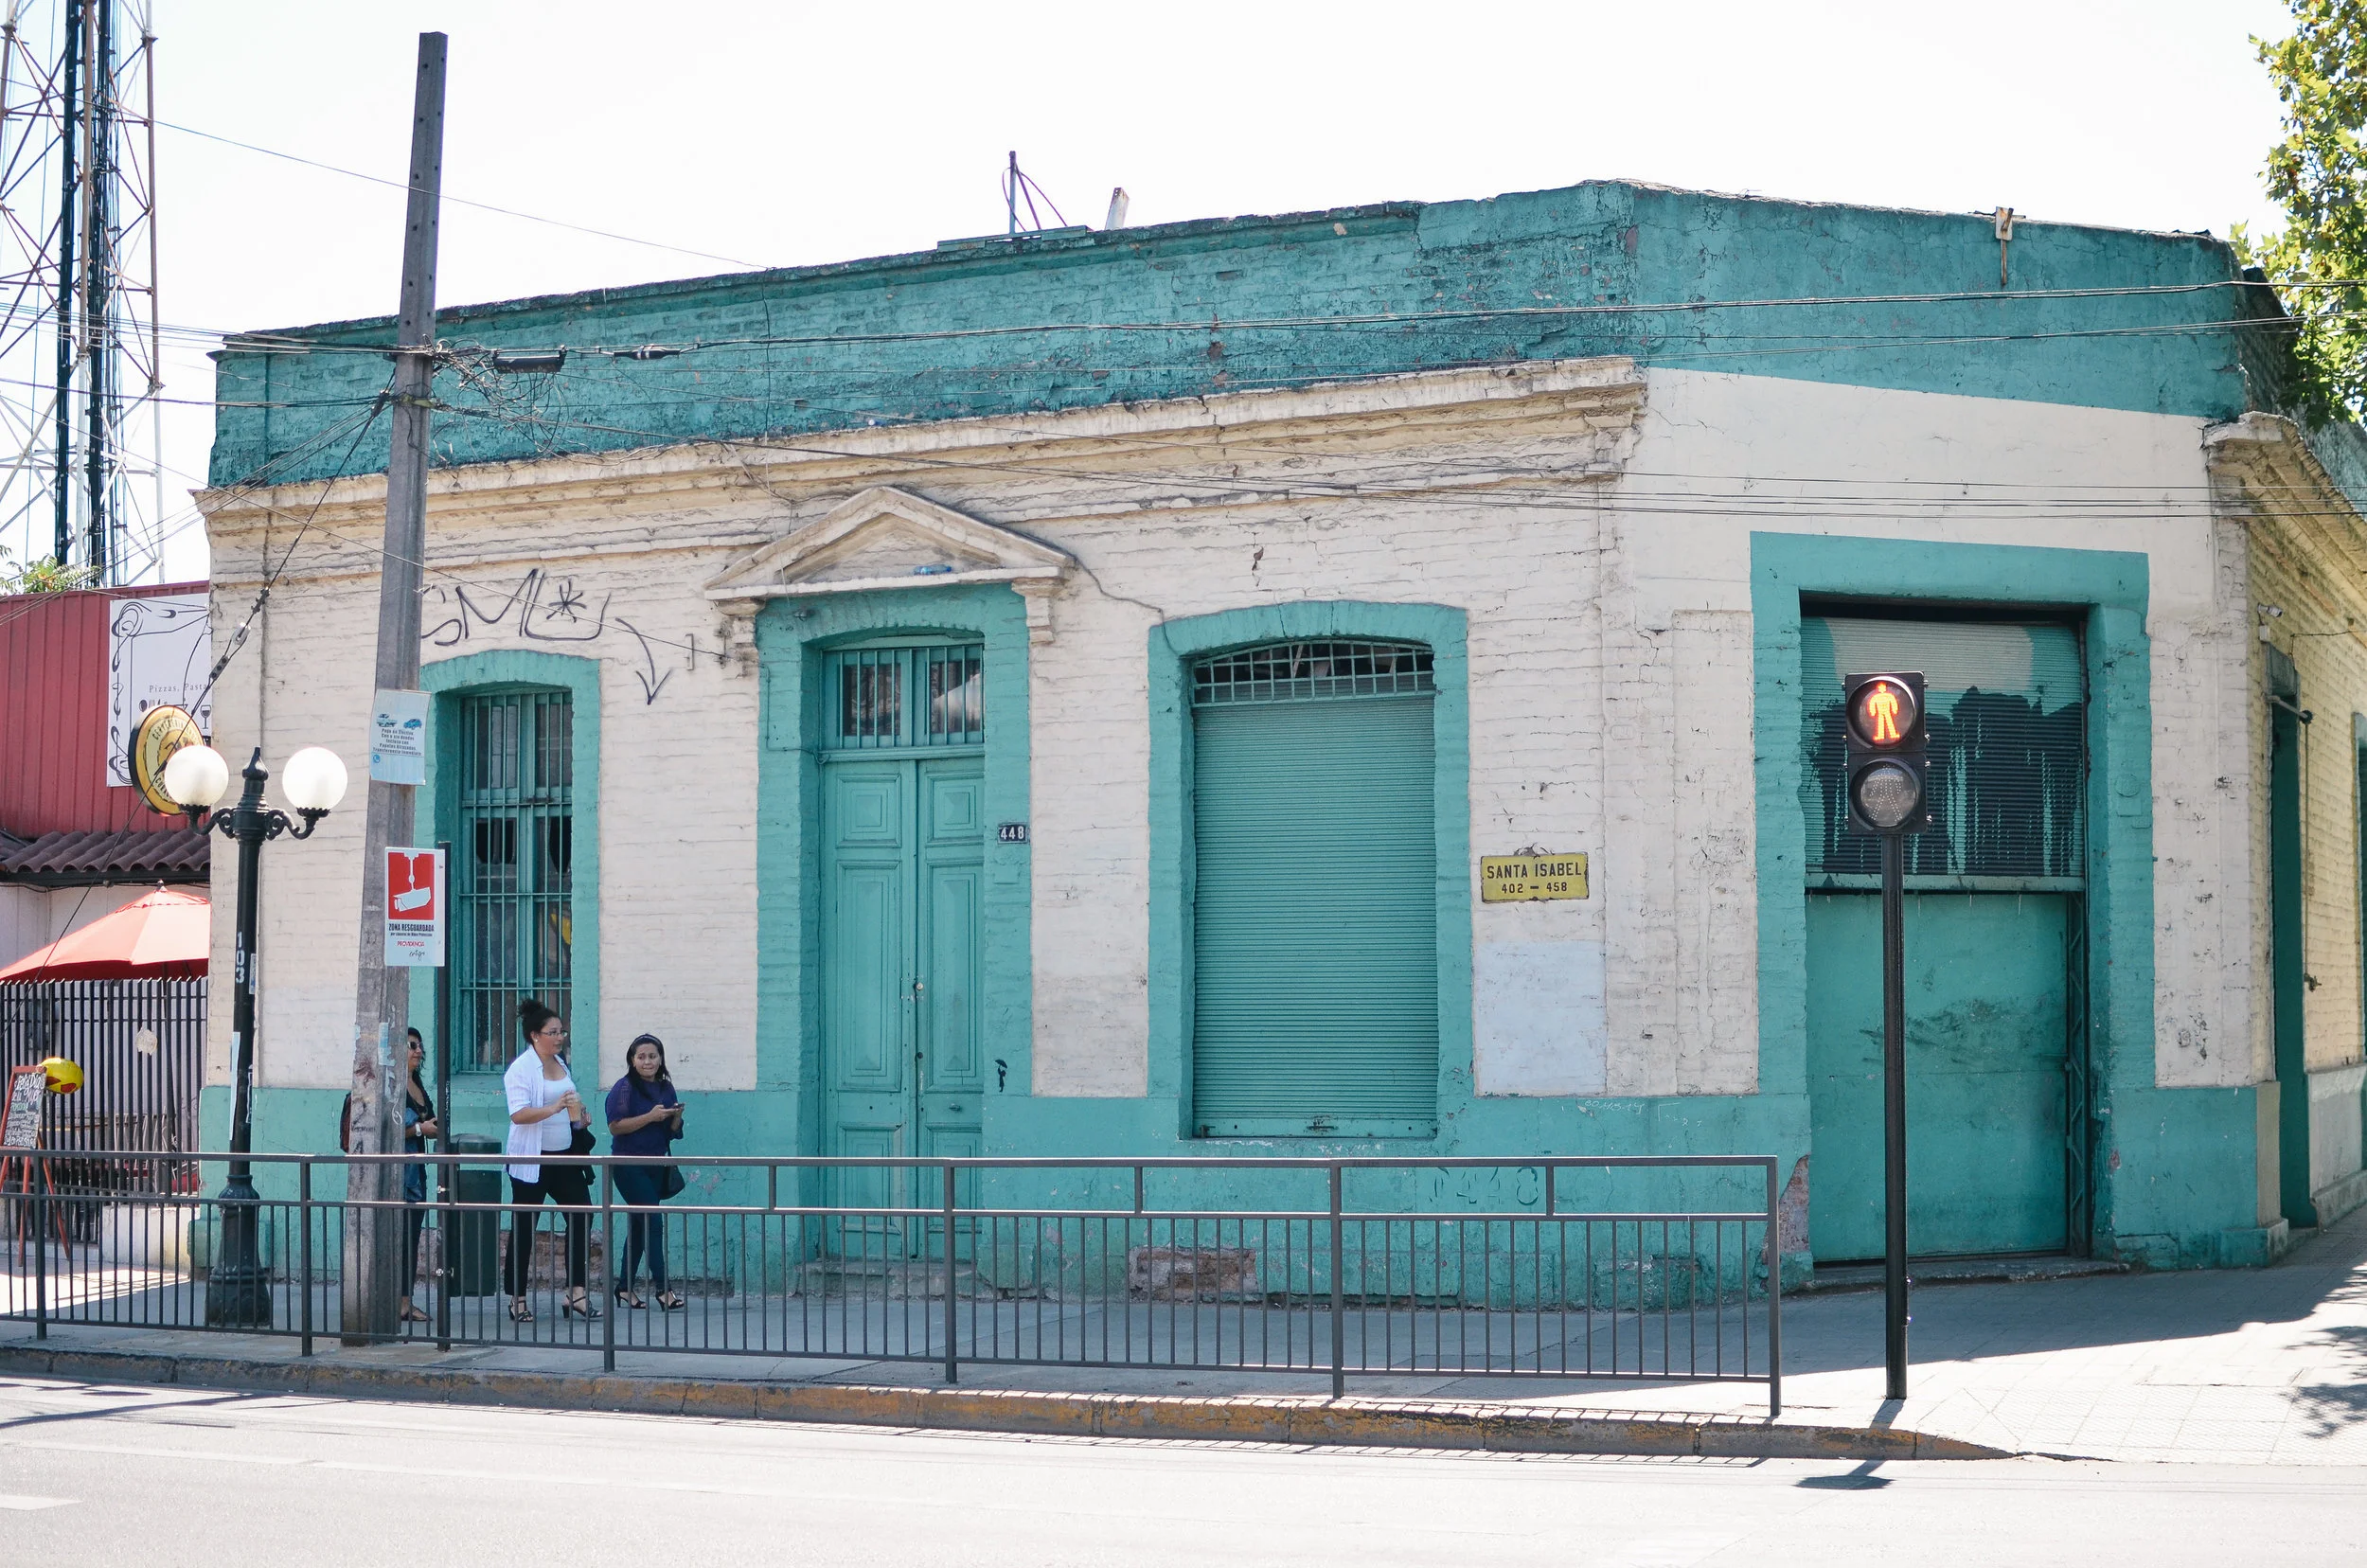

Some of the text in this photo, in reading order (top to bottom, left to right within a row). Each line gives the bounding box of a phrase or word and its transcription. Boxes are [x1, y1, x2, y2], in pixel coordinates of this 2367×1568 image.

[1001, 826, 1024, 840] 448
[1486, 862, 1582, 879] SANTA ISABEL
[1501, 883, 1523, 894] 402
[1546, 882, 1568, 893] 458
[236, 932, 245, 984] 103
